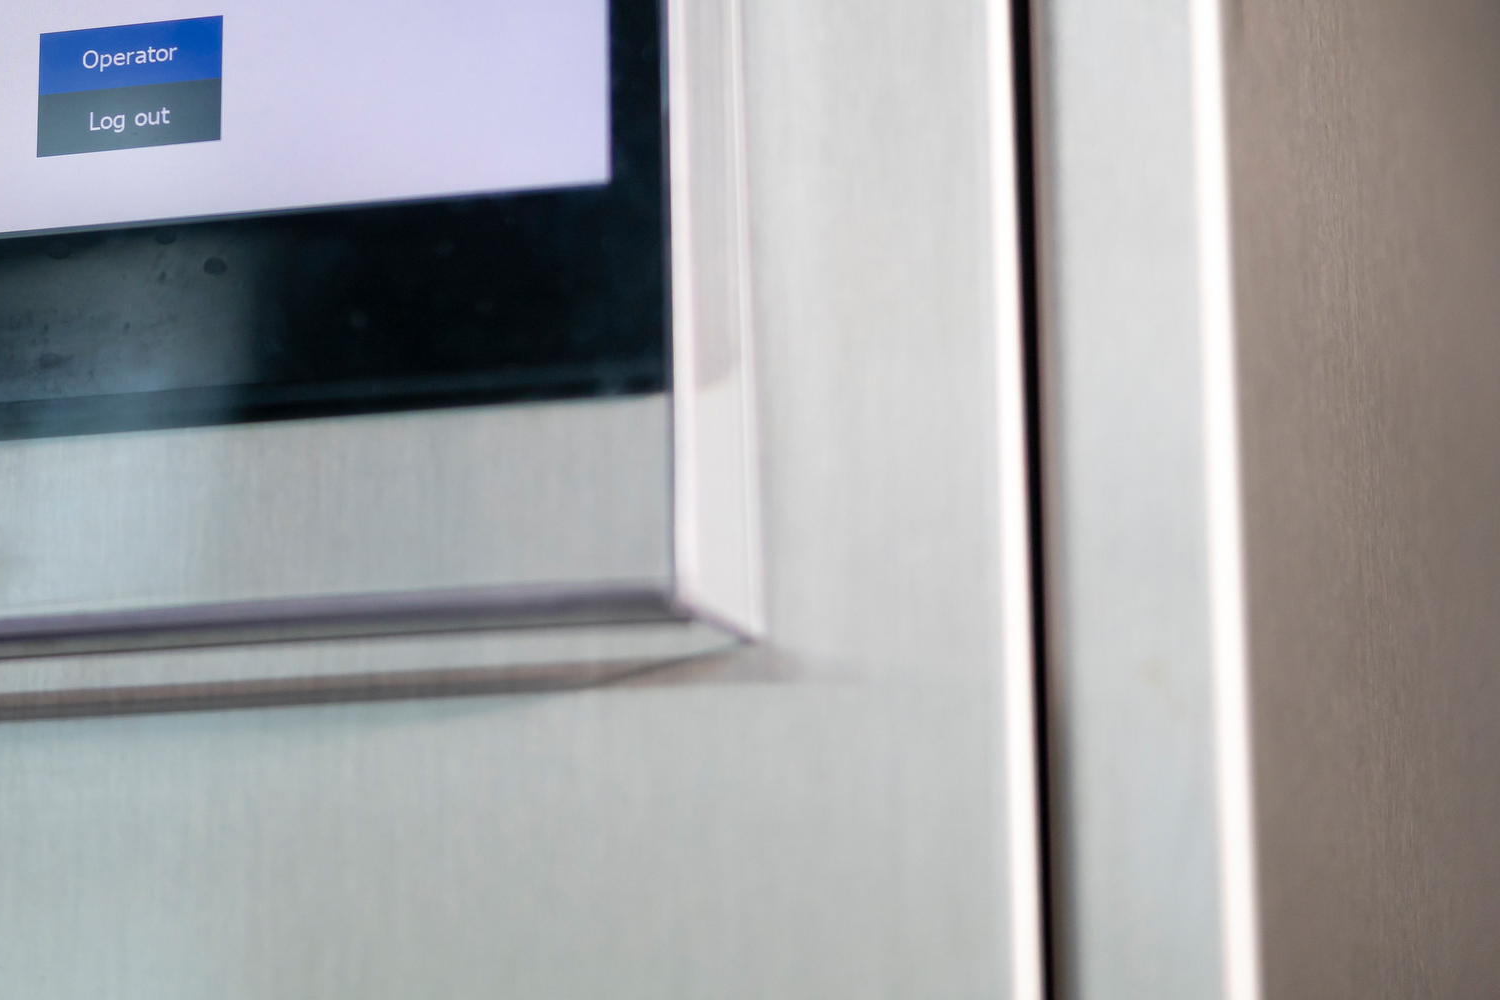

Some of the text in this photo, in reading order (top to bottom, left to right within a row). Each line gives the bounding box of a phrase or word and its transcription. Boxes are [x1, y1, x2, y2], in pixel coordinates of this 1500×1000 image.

[82, 46, 177, 72] Operator
[89, 107, 171, 134] Log out
